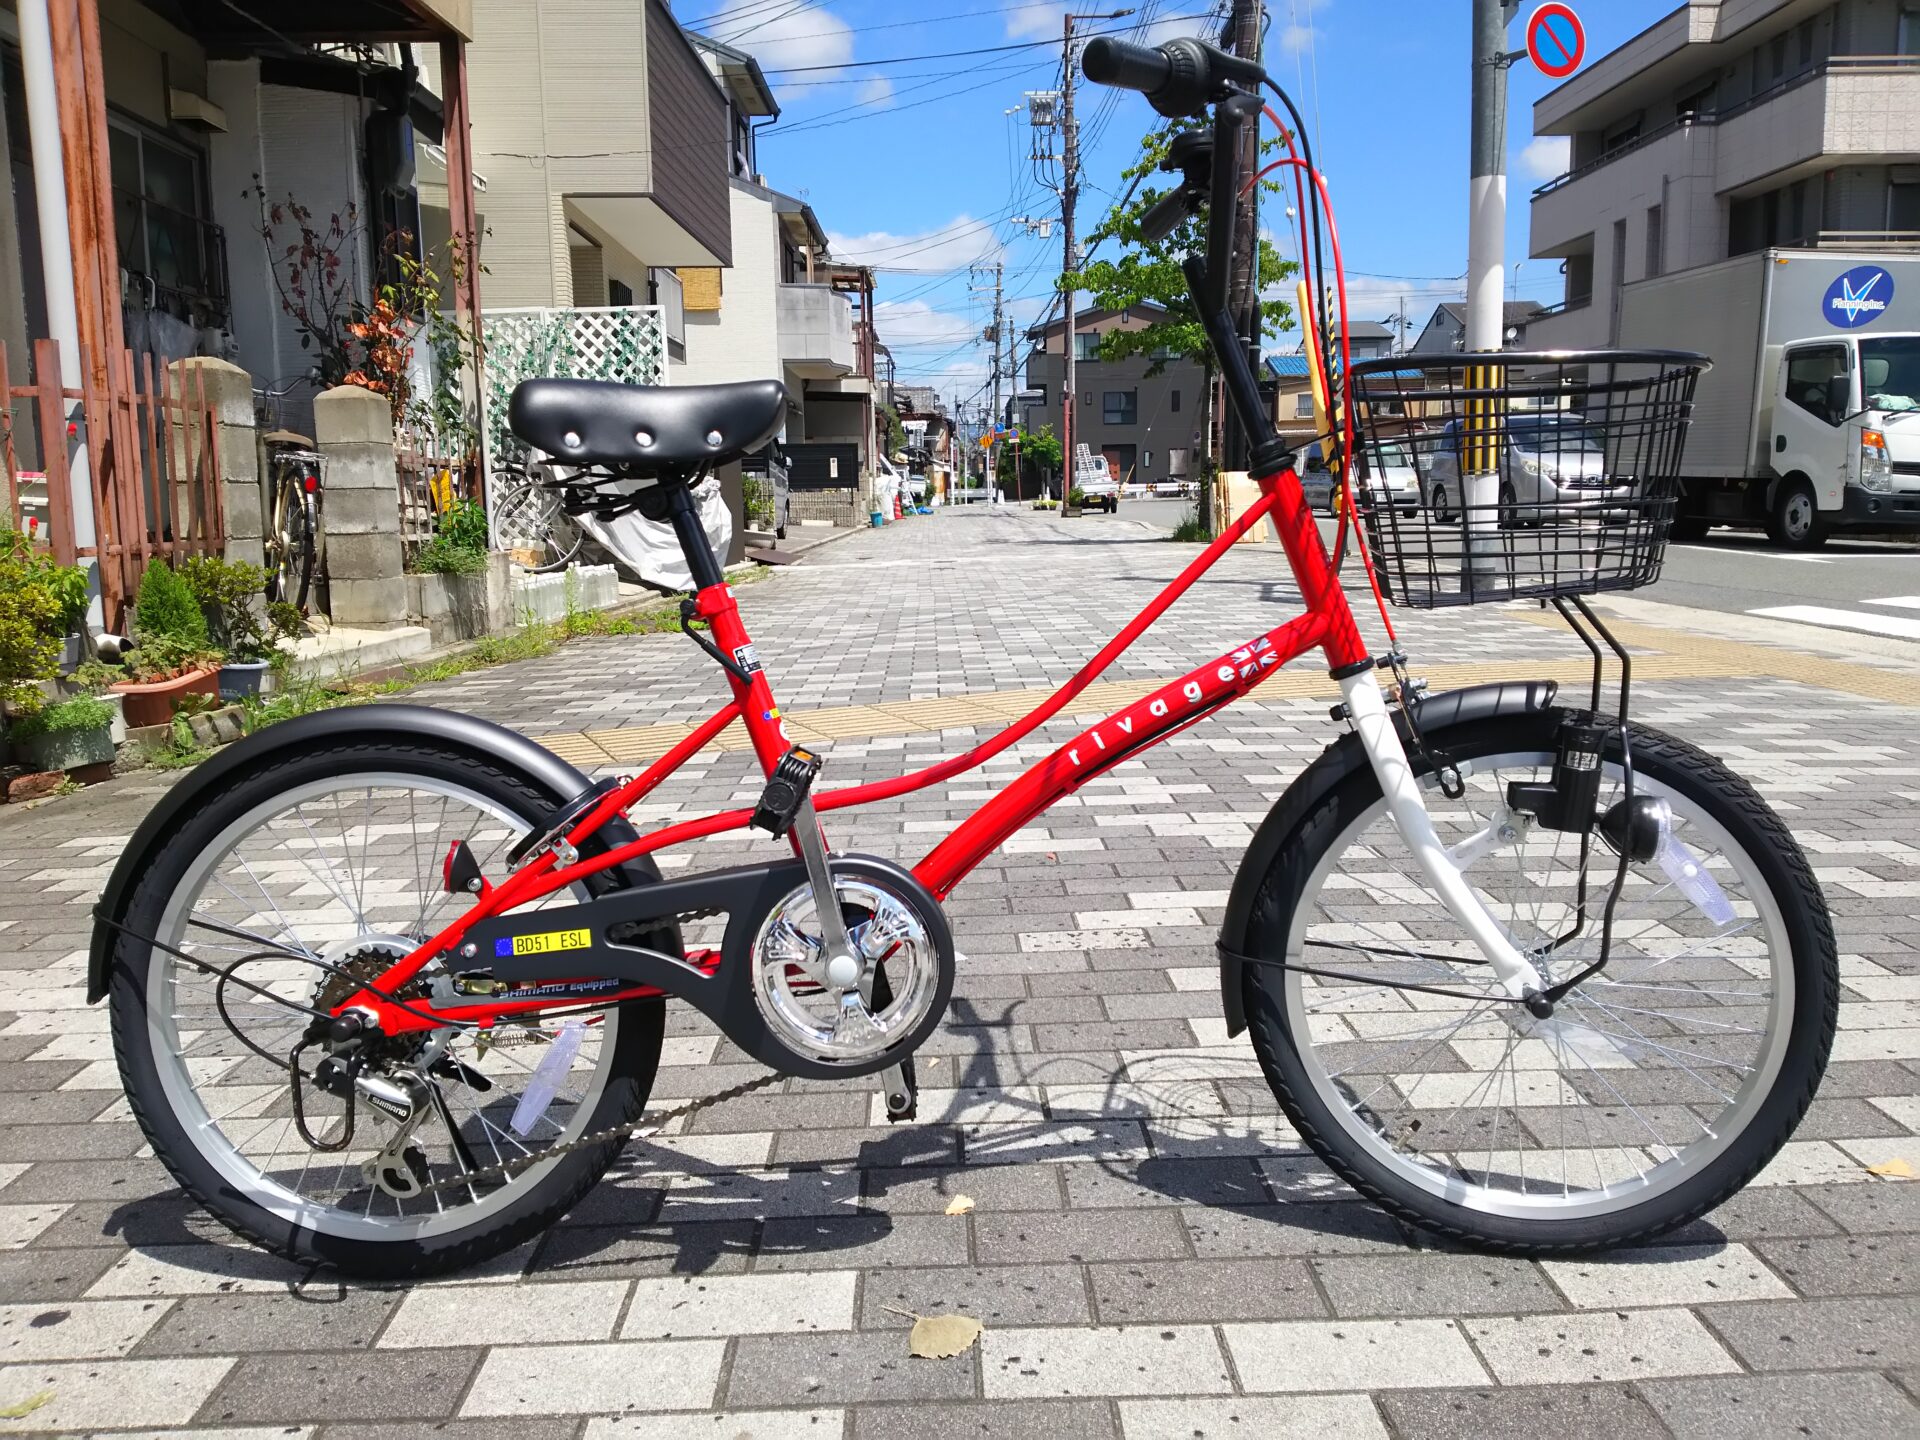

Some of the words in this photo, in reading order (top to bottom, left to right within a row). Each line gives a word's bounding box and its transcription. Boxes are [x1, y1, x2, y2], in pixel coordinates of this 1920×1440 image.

[1832, 297, 1869, 311] Planning
[1068, 665, 1236, 766] rivage
[516, 935, 550, 953] BD51
[560, 931, 587, 948] ESL
[569, 978, 620, 992] Equipped
[371, 1096, 408, 1118] SHIMANO
